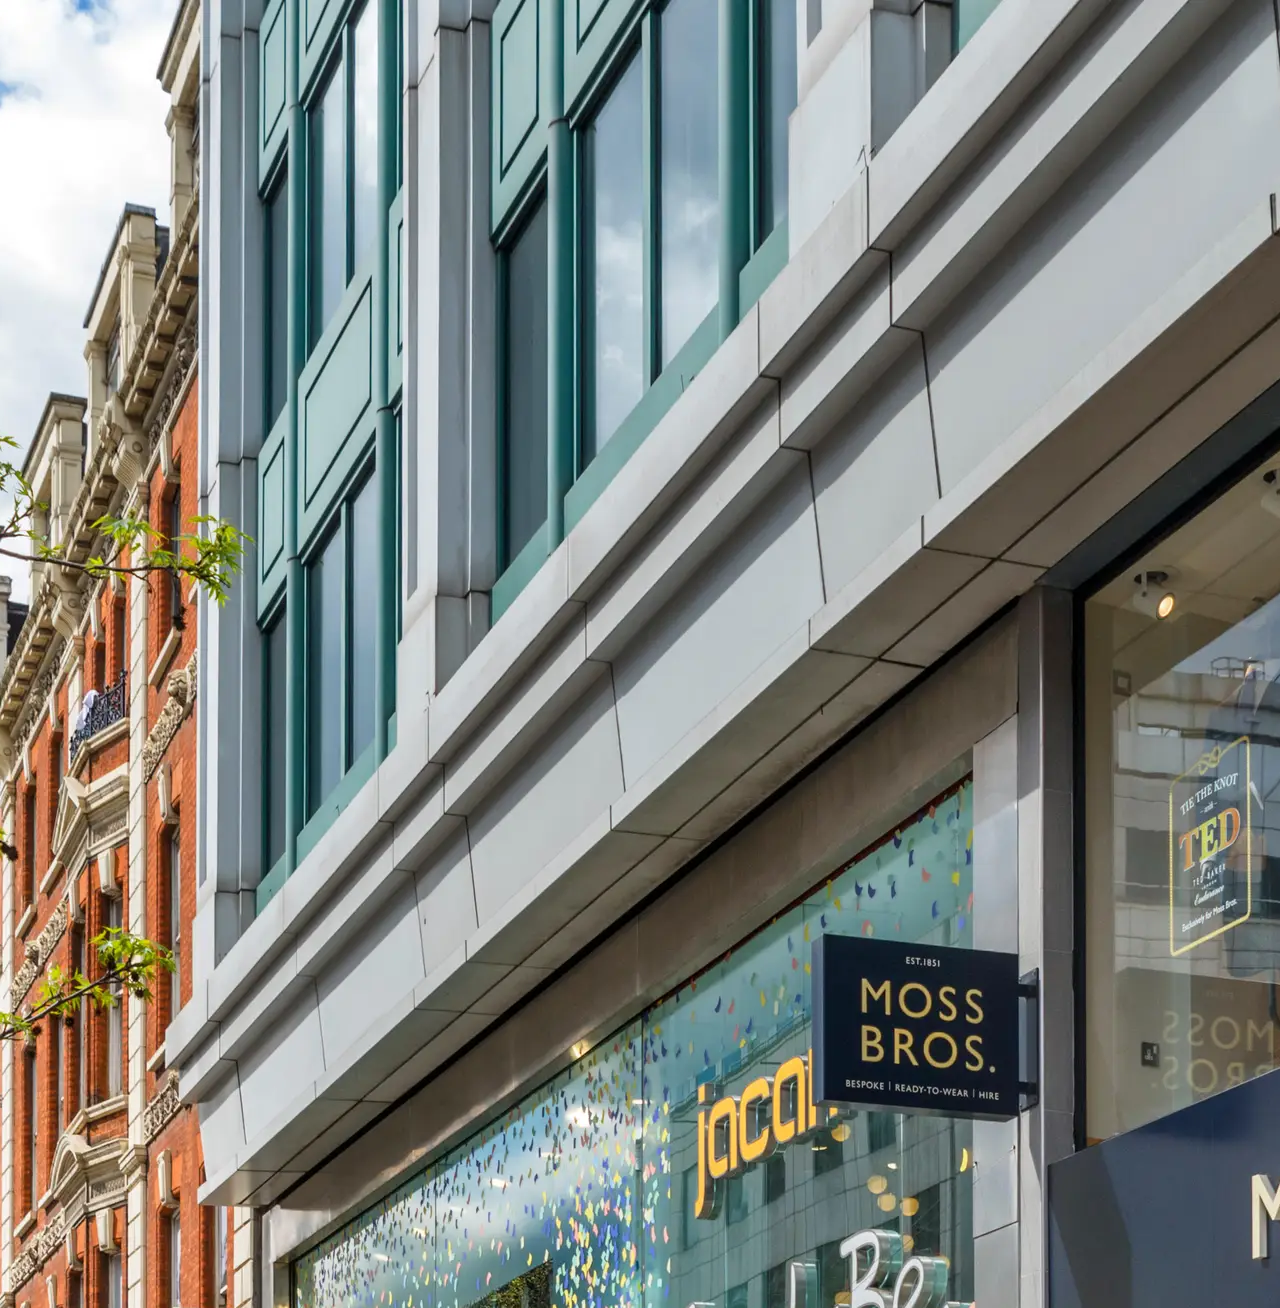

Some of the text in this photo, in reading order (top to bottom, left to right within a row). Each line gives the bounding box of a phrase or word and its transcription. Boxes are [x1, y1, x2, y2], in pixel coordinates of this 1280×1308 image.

[1180, 772, 1239, 815] TIE THE KNOT
[1179, 807, 1241, 872] TED
[1182, 914, 1205, 932] Exclusively
[1205, 911, 1213, 920] for
[1213, 905, 1225, 915] Moss
[905, 956, 941, 967] EST.1851
[861, 977, 984, 1025] MOSS
[861, 1024, 996, 1073] BROS.
[845, 1079, 1000, 1101] BESPOKE READY-TO-WEAR HIRE
[694, 1048, 838, 1219] jaca
